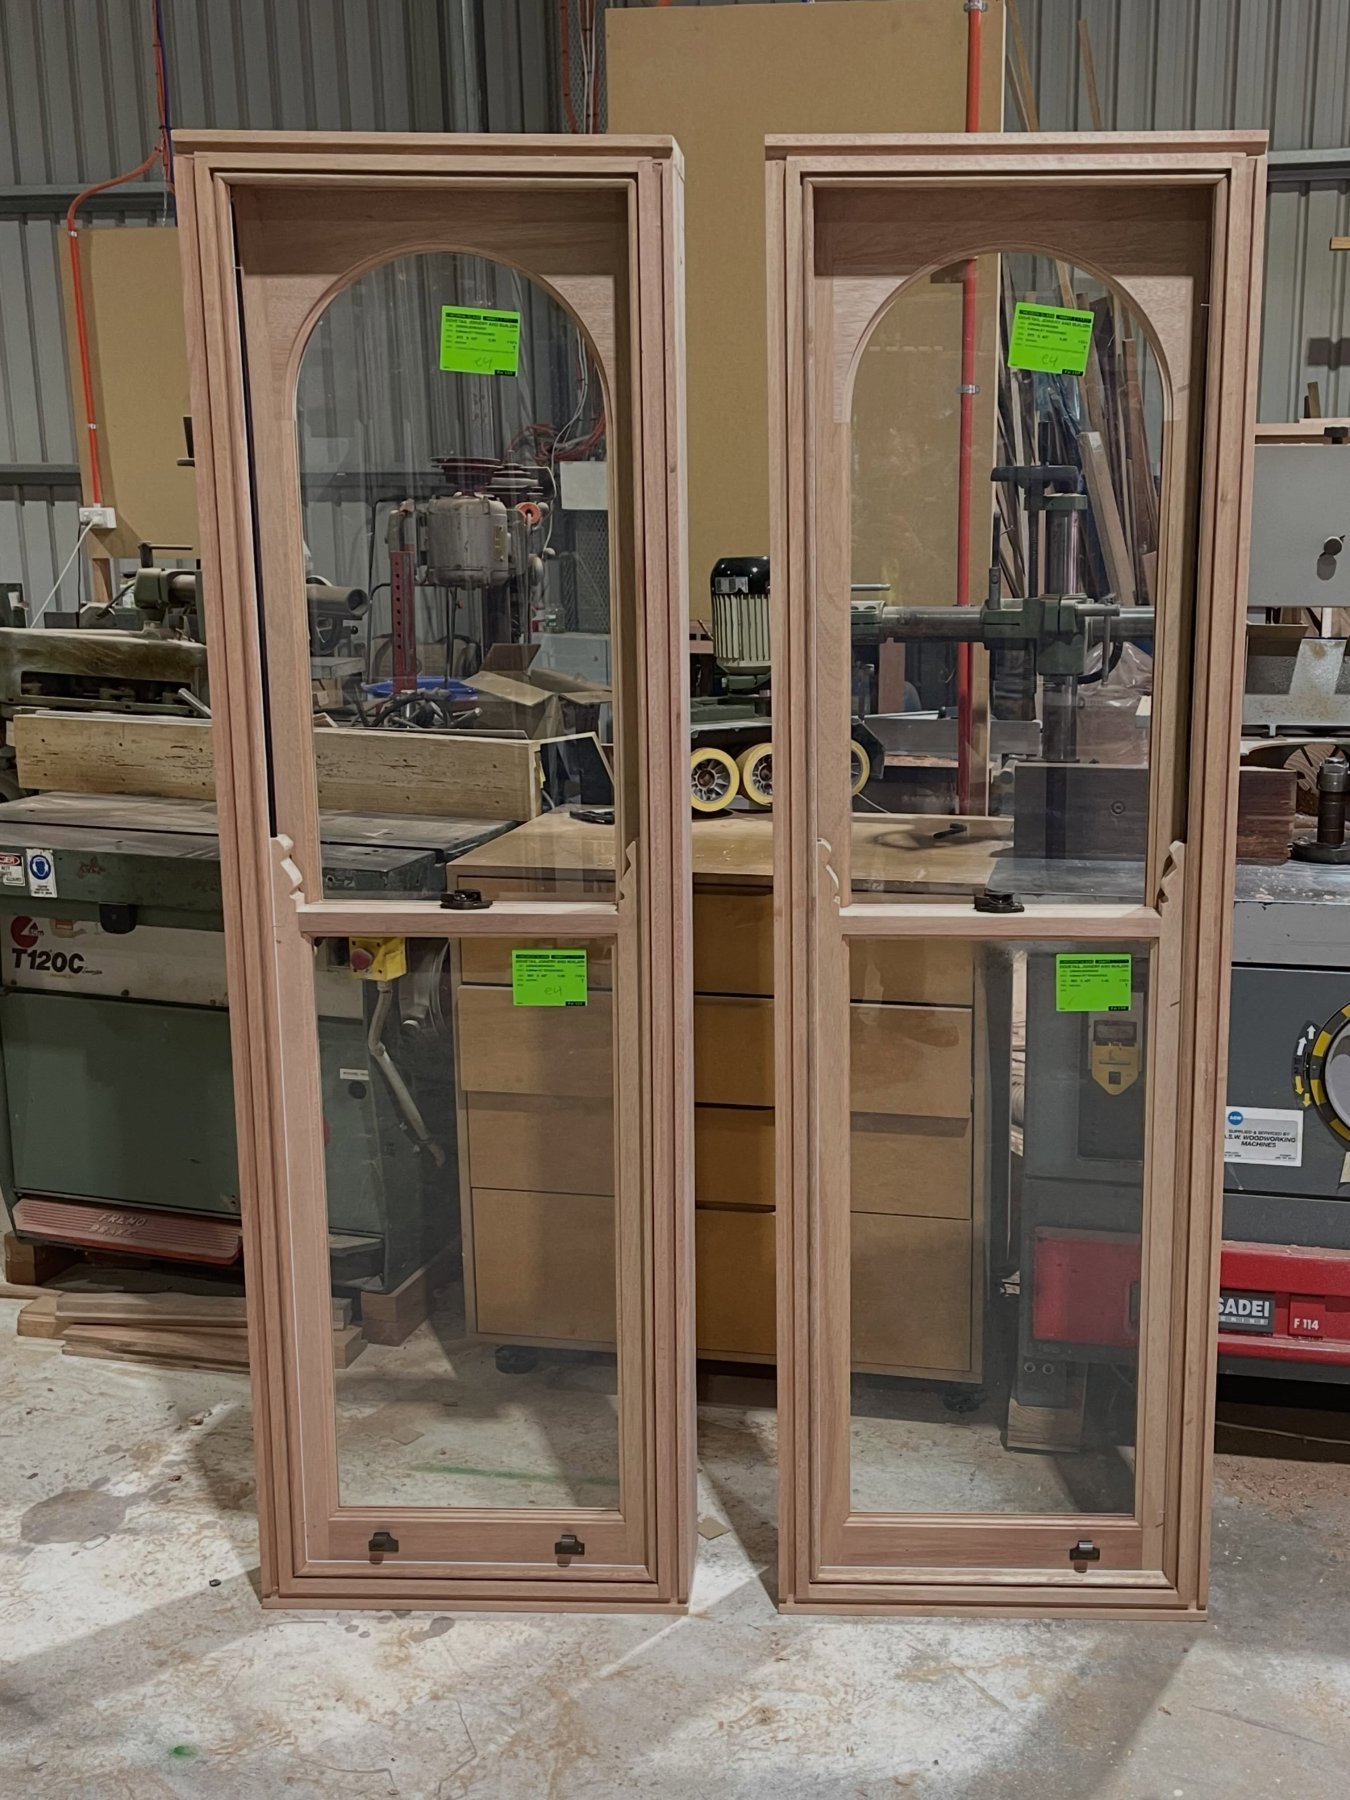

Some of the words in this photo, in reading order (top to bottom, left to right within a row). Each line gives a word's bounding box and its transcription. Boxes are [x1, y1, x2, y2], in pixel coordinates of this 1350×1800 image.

[11, 947, 85, 974] T120C
[1242, 1135, 1296, 1143] WOODWORKING
[1293, 1317, 1301, 1329] F
[1302, 1318, 1320, 1331] 114
